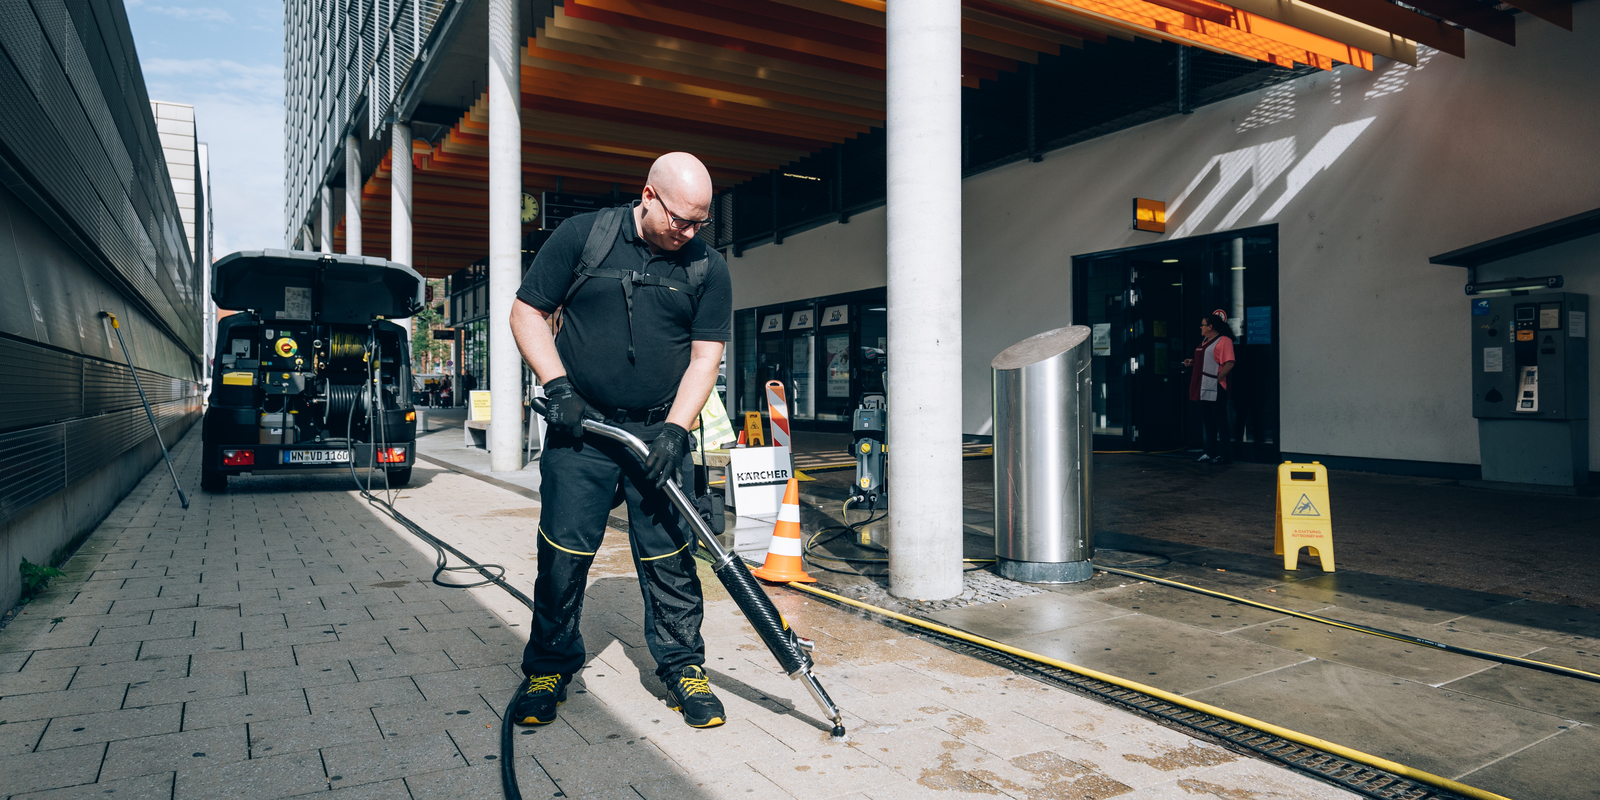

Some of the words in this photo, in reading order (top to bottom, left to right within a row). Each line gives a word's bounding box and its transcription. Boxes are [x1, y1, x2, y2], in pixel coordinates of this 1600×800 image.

[1548, 277, 1556, 287] P
[1466, 285, 1473, 294] P
[292, 451, 304, 461] WN
[310, 451, 322, 461] VD
[325, 451, 348, 460] 1160
[736, 469, 788, 481] KÄRCHER
